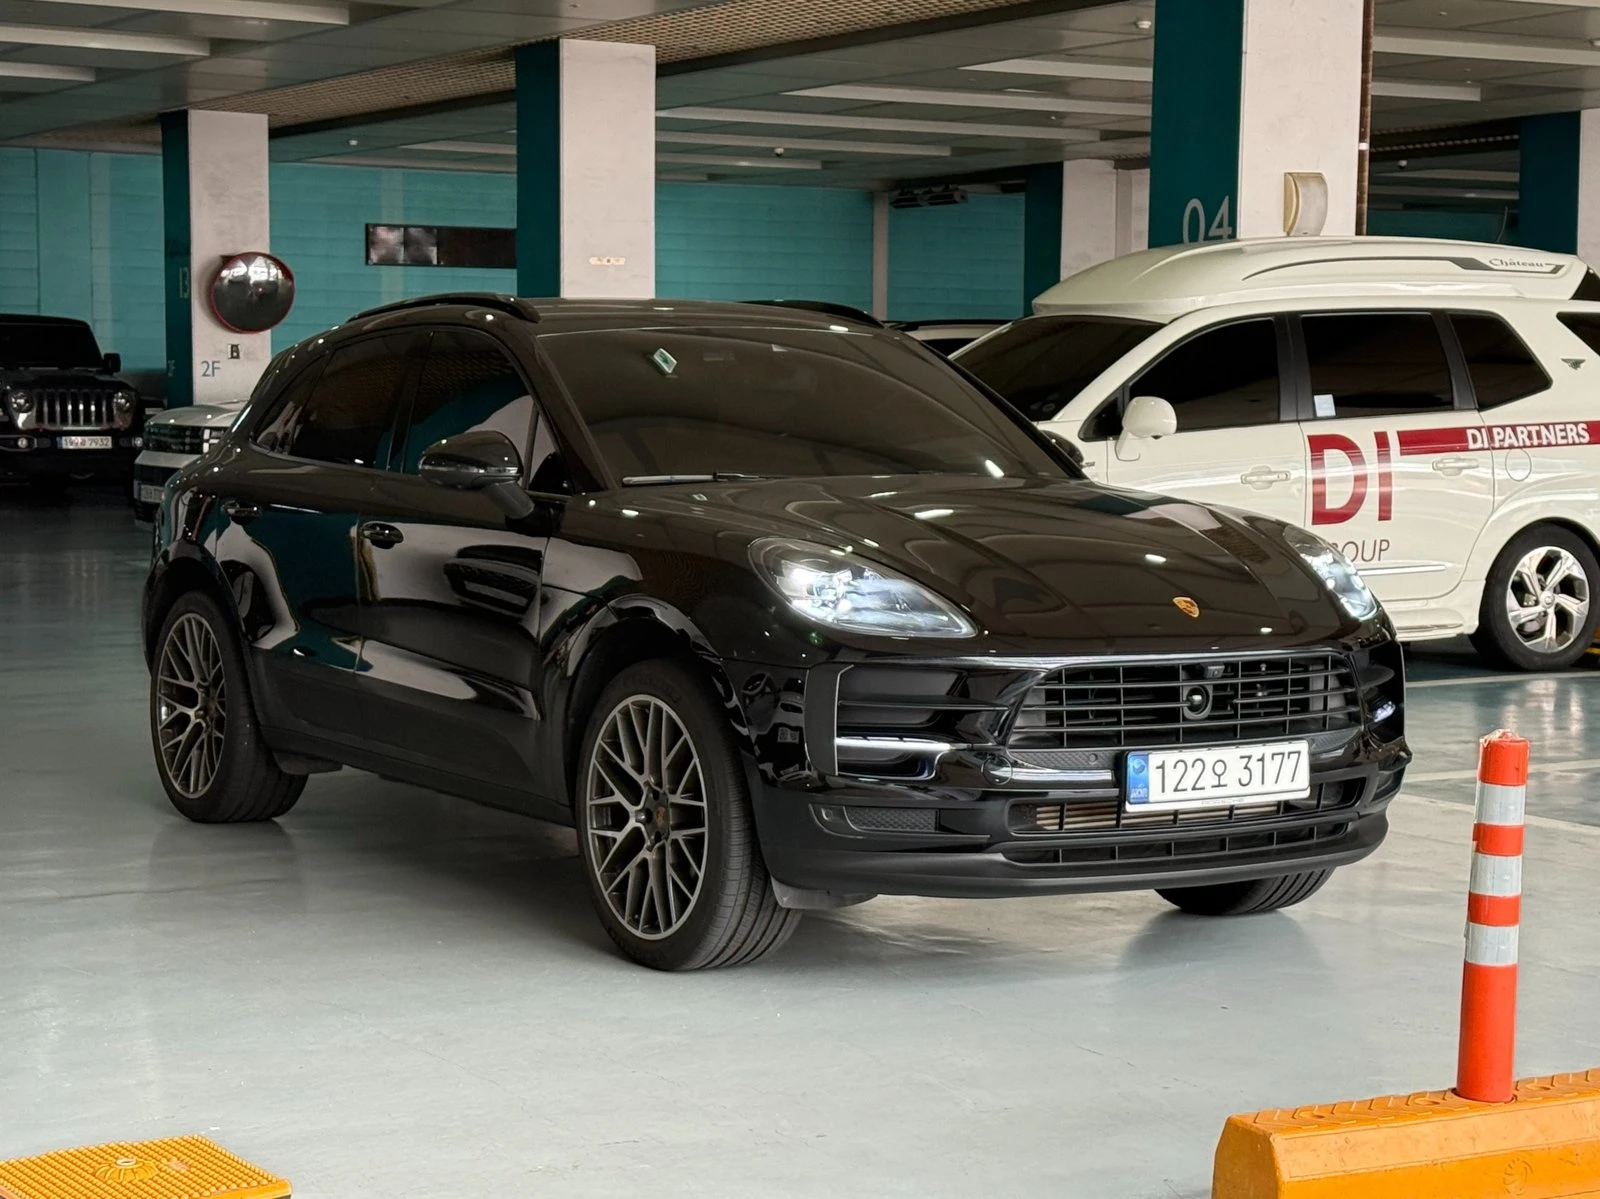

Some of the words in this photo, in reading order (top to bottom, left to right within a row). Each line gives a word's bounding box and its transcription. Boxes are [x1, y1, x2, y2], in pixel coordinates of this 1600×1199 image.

[1183, 195, 1232, 244] 04
[201, 360, 221, 377] 2F
[1466, 428, 1489, 450] DI
[1492, 423, 1590, 449] PARTNERS
[1307, 431, 1392, 525] DI
[1155, 758, 1228, 794] 122오
[1238, 750, 1301, 788] 3177
